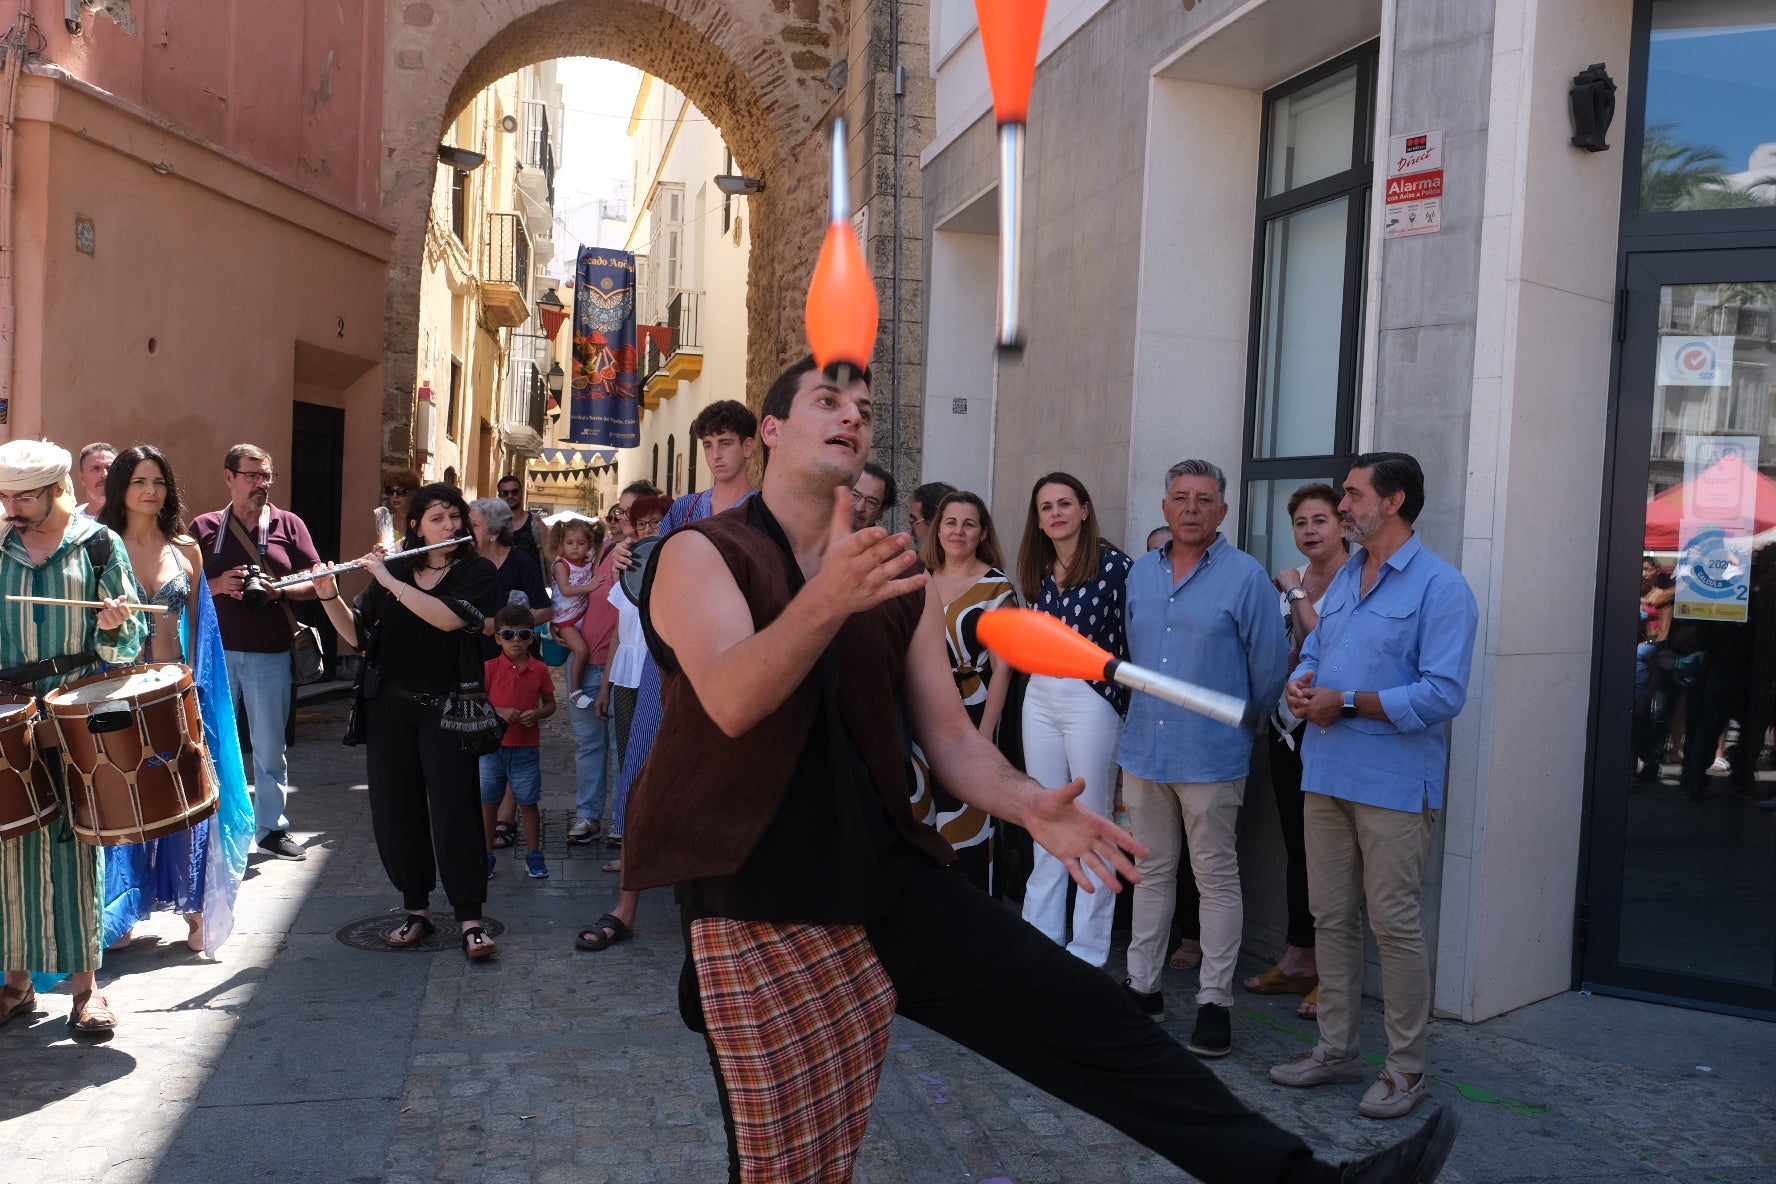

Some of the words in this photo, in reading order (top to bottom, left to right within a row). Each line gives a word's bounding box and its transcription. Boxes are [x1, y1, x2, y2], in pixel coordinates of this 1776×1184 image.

[1388, 178, 1440, 194] Alarma
[1400, 192, 1415, 200] Aviso
[1698, 371, 1715, 380] SGS
[1736, 584, 1748, 601] 2
